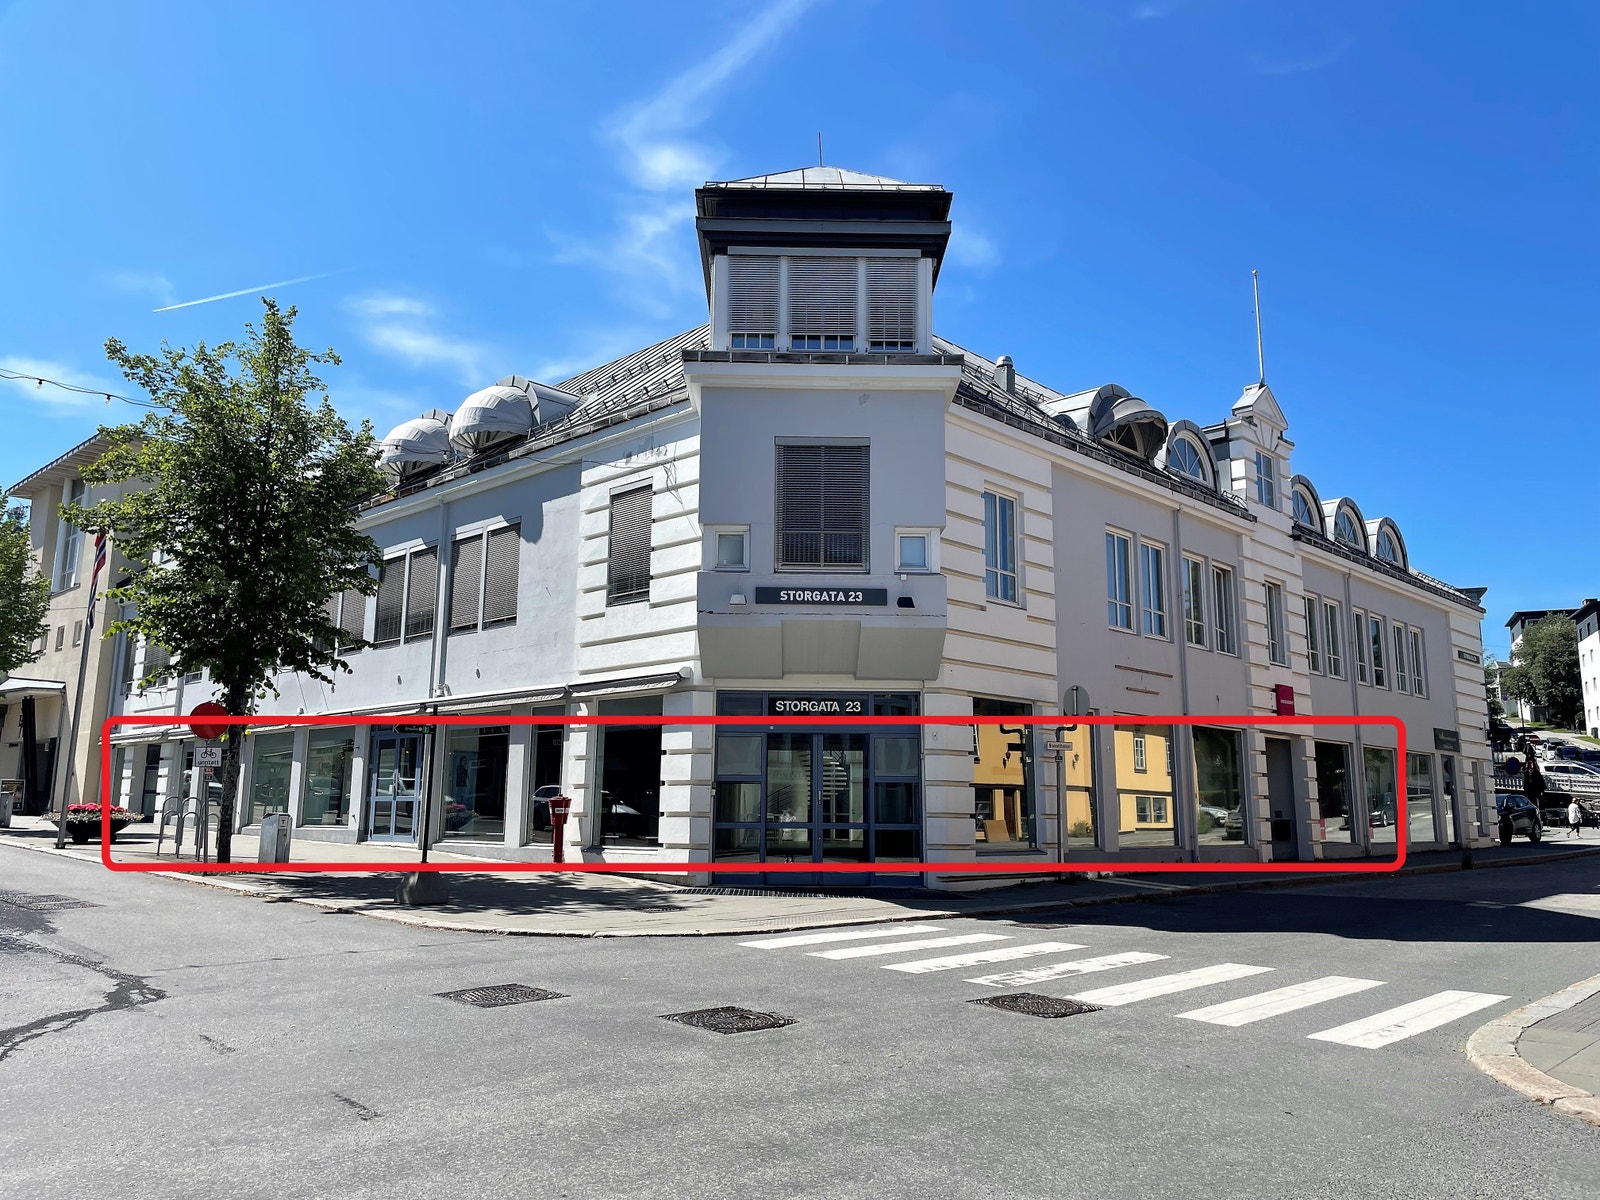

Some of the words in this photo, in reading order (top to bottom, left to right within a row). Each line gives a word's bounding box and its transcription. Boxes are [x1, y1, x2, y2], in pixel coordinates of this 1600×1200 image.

[780, 590, 846, 602] STORGATA
[848, 591, 863, 602] 23
[775, 700, 840, 712] STORGATA
[845, 701, 861, 712] 23
